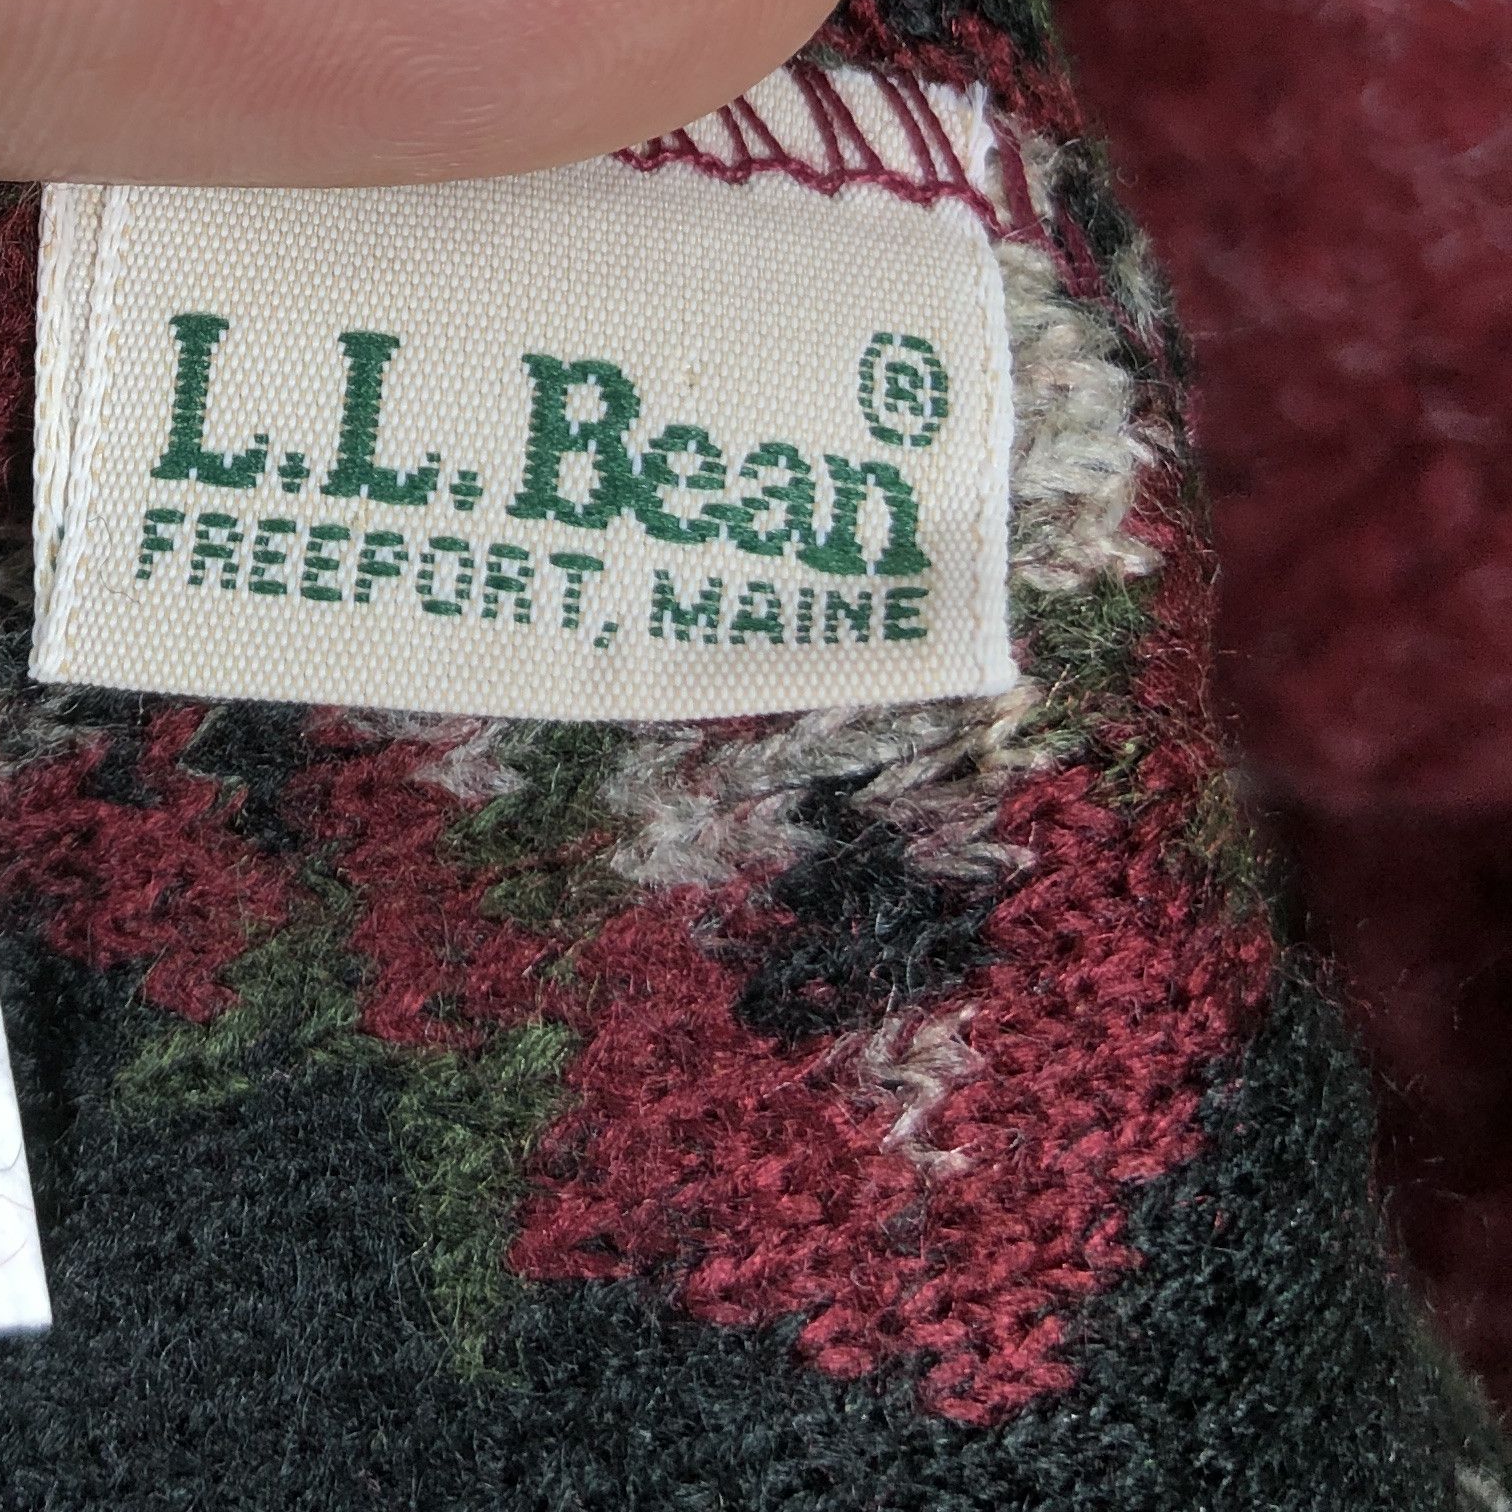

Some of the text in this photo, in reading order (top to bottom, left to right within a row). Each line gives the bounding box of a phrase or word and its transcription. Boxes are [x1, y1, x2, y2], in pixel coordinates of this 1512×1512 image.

[505, 352, 933, 577] Bean
[133, 507, 931, 650] FREEPORT, MAINE
